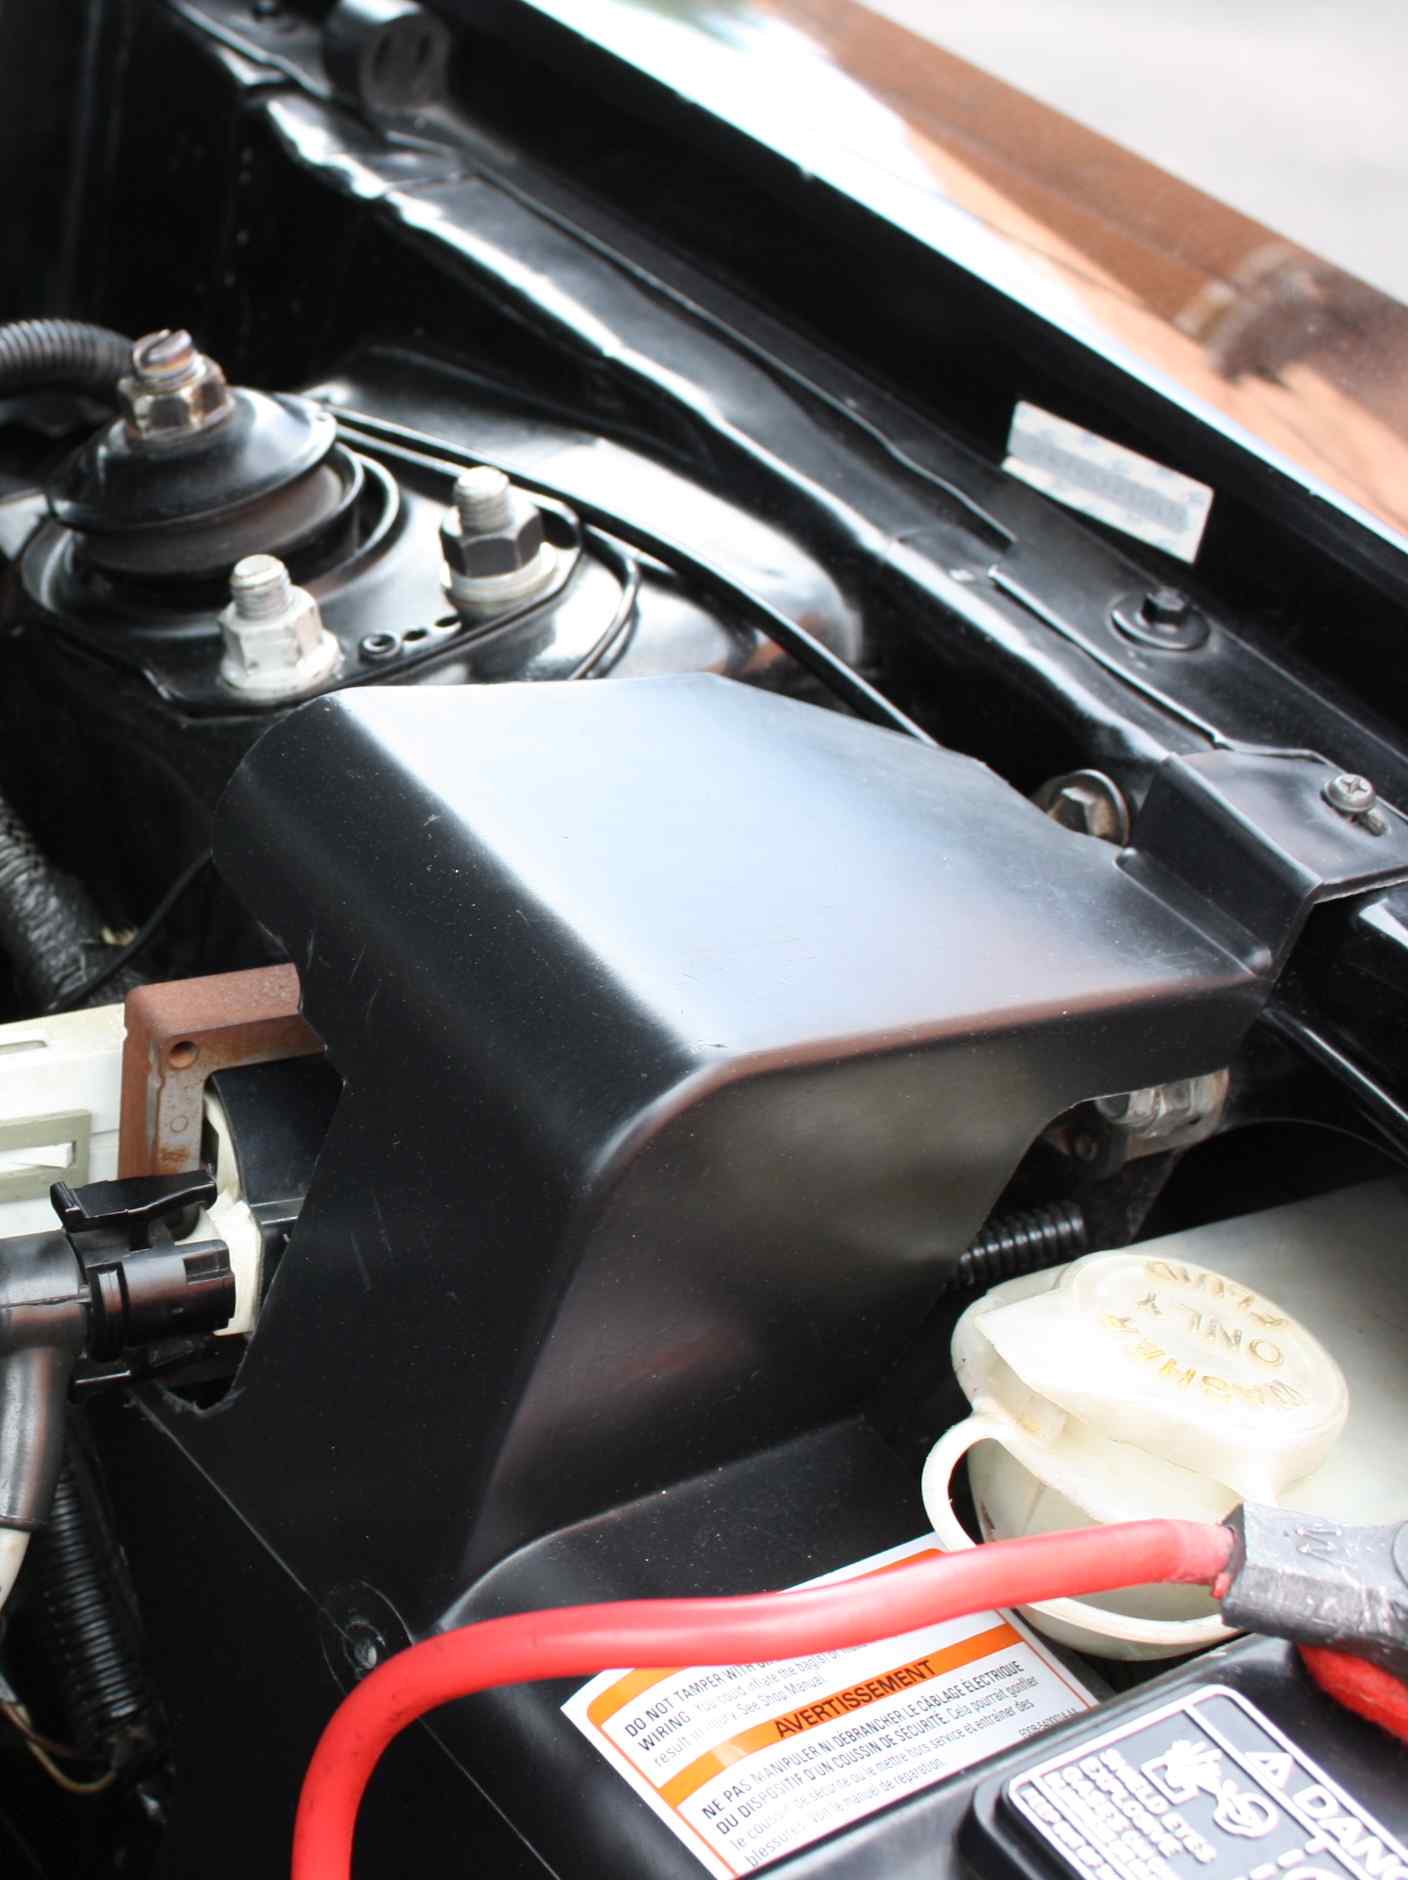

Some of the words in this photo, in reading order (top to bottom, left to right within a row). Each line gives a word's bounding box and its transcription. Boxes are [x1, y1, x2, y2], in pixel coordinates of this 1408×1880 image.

[624, 1717, 647, 1738] DO
[645, 1697, 675, 1722] NOT
[673, 1672, 725, 1703] TAMPER
[774, 1660, 936, 1739] AVERTISSEMENT
[929, 1728, 966, 1750] service
[653, 1735, 693, 1768] result
[701, 1798, 725, 1820] NE
[723, 1778, 752, 1803] PAS
[750, 1745, 821, 1786] MANIPULER
[818, 1739, 836, 1753] NI
[903, 1703, 920, 1719] LE
[716, 1814, 739, 1835] DU
[737, 1773, 804, 1818] DISPOSITIF
[831, 1737, 882, 1769] COUSSIN
[879, 1734, 897, 1750] DE
[1097, 1748, 1169, 1816] SHIELD
[1160, 1812, 1217, 1864] EYES
